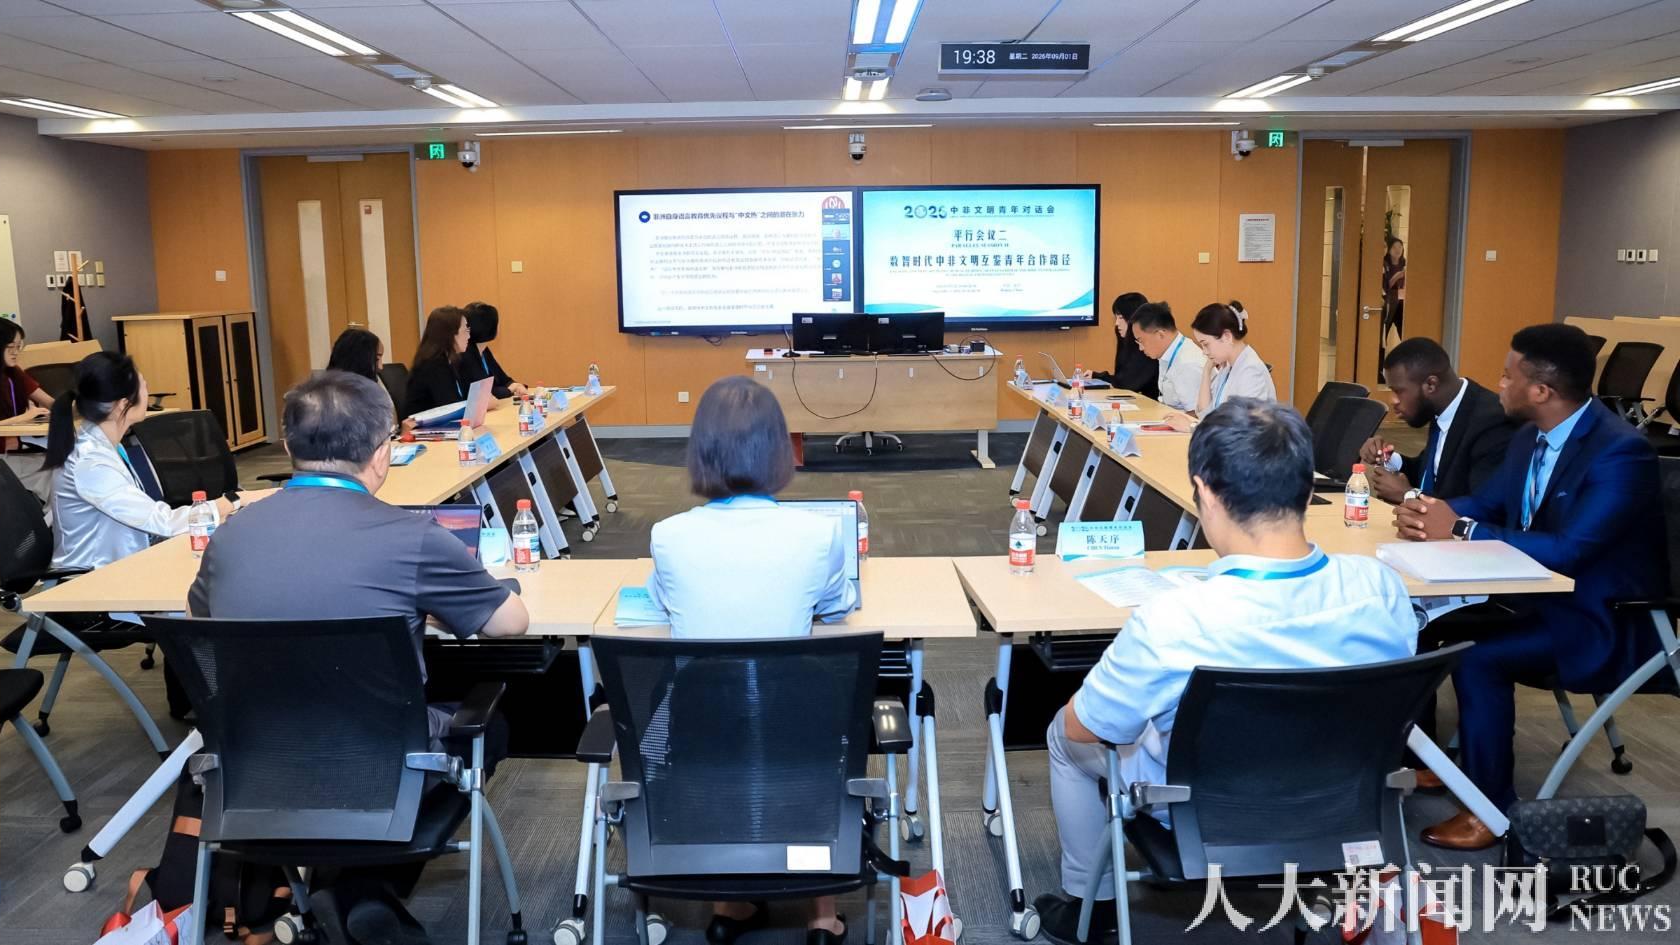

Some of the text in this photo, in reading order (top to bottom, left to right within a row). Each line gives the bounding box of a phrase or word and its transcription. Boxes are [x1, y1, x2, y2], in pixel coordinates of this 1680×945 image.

[954, 50, 996, 64] 19:38
[950, 205, 1054, 214] 中非文明青年对话会
[954, 229, 1007, 241] 平行会议二
[889, 254, 1071, 266] 数智时代中非文明互鉴青年合作路径
